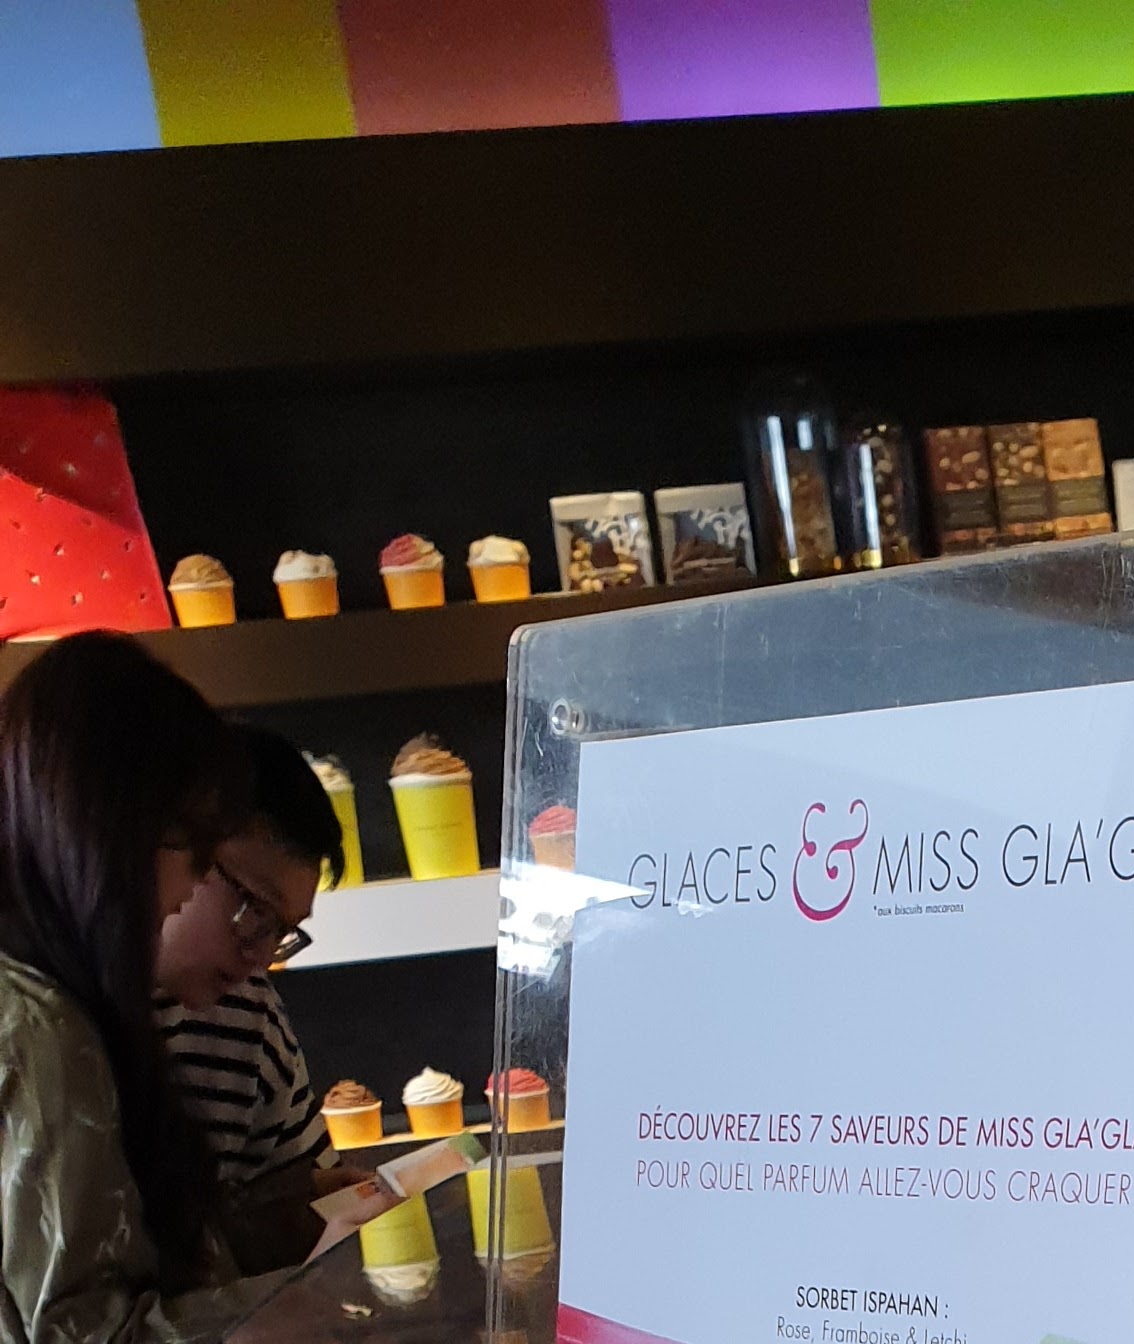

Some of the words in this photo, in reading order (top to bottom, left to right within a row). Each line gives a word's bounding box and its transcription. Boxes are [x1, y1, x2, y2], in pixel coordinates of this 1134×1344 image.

[629, 843, 777, 909] GLACES
[793, 799, 868, 921] &
[873, 829, 980, 896] MISS
[637, 1104, 761, 1144] DÉCOUVREZ
[767, 1113, 802, 1144] LES
[808, 1114, 823, 1145] 7
[830, 1114, 930, 1147] SAVEURS
[937, 1116, 967, 1147] DE
[975, 1116, 1035, 1149] MISS
[636, 1160, 690, 1189] POUR
[699, 1161, 754, 1193] QUEL
[763, 1163, 849, 1195] PARFUM
[859, 1166, 997, 1201] ALLEZ-VOUS
[1007, 1170, 1133, 1206] CRAQUER
[796, 1285, 858, 1312] SORBET
[863, 1291, 938, 1318] ISPAHAN
[776, 1316, 815, 1344] Rose,
